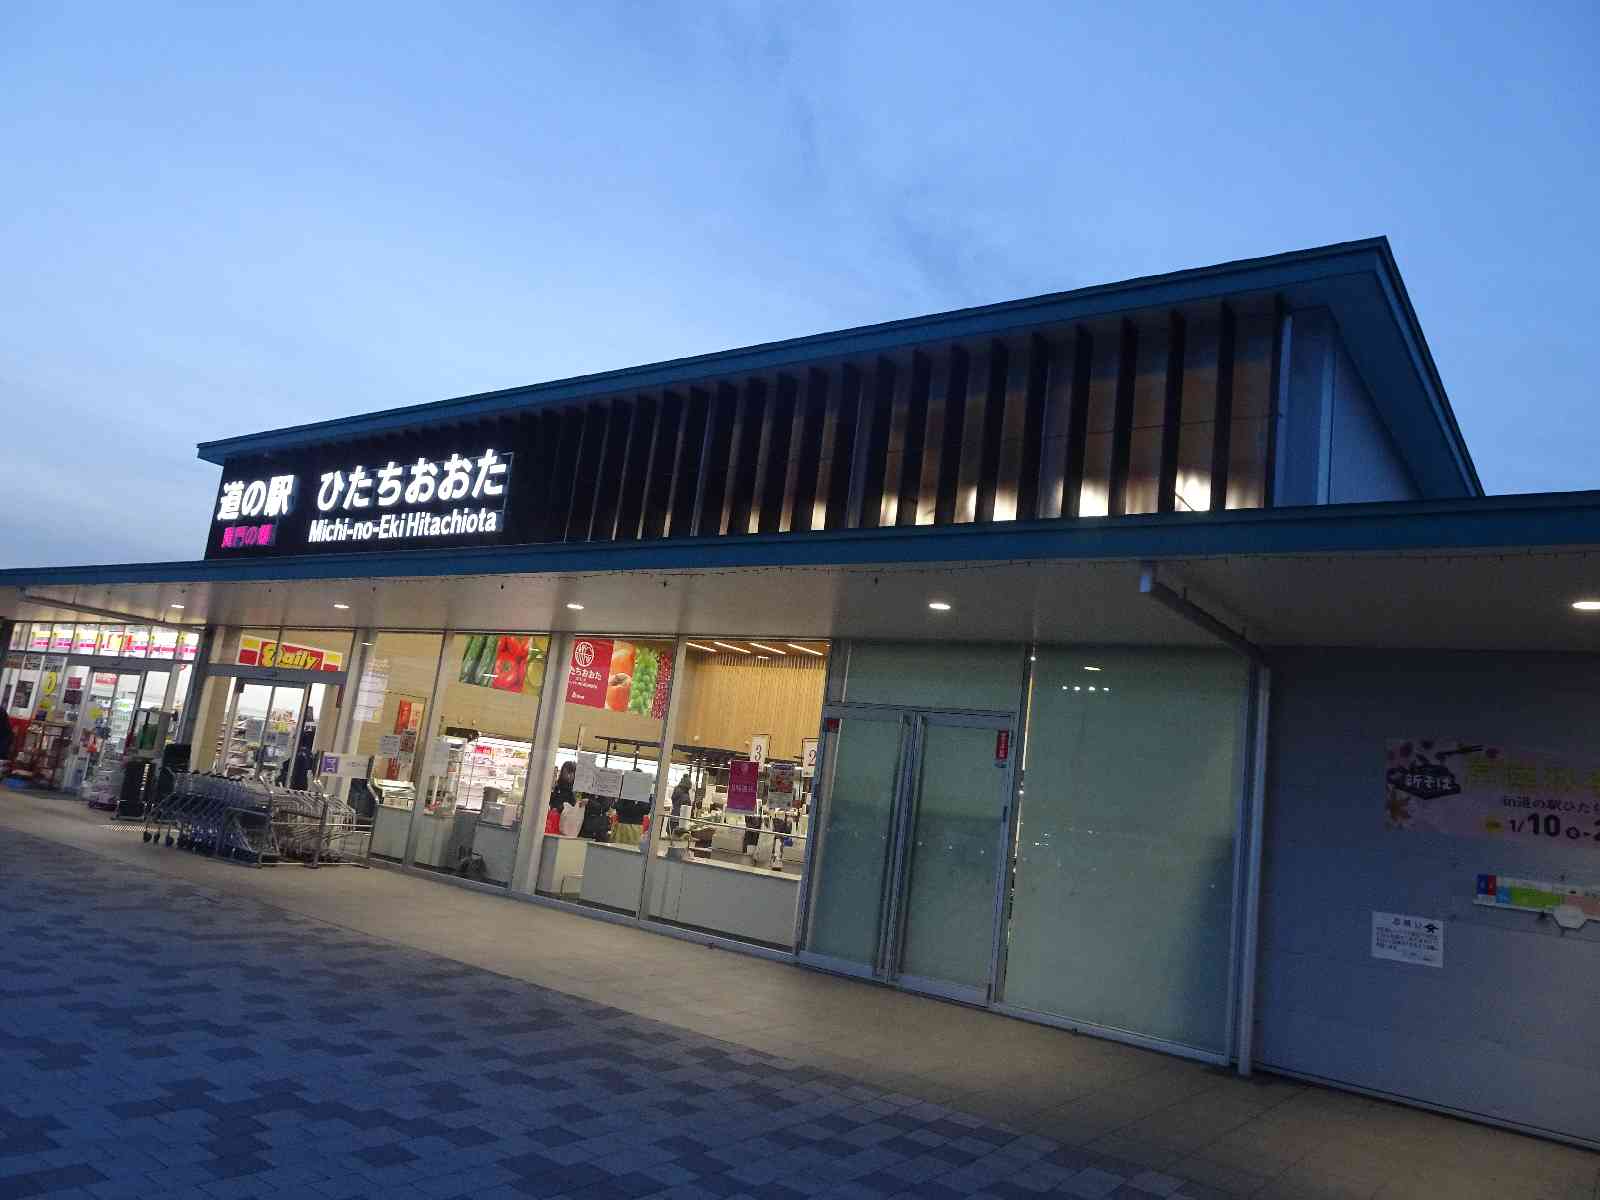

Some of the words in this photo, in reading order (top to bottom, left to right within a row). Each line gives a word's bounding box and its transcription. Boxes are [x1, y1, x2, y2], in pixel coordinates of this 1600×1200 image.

[217, 474, 296, 520] 道の駅
[316, 448, 506, 511] ひたちおおた
[308, 513, 406, 543] Michi-no-Eki
[406, 507, 497, 536] Hitachiota
[754, 744, 762, 761] 3
